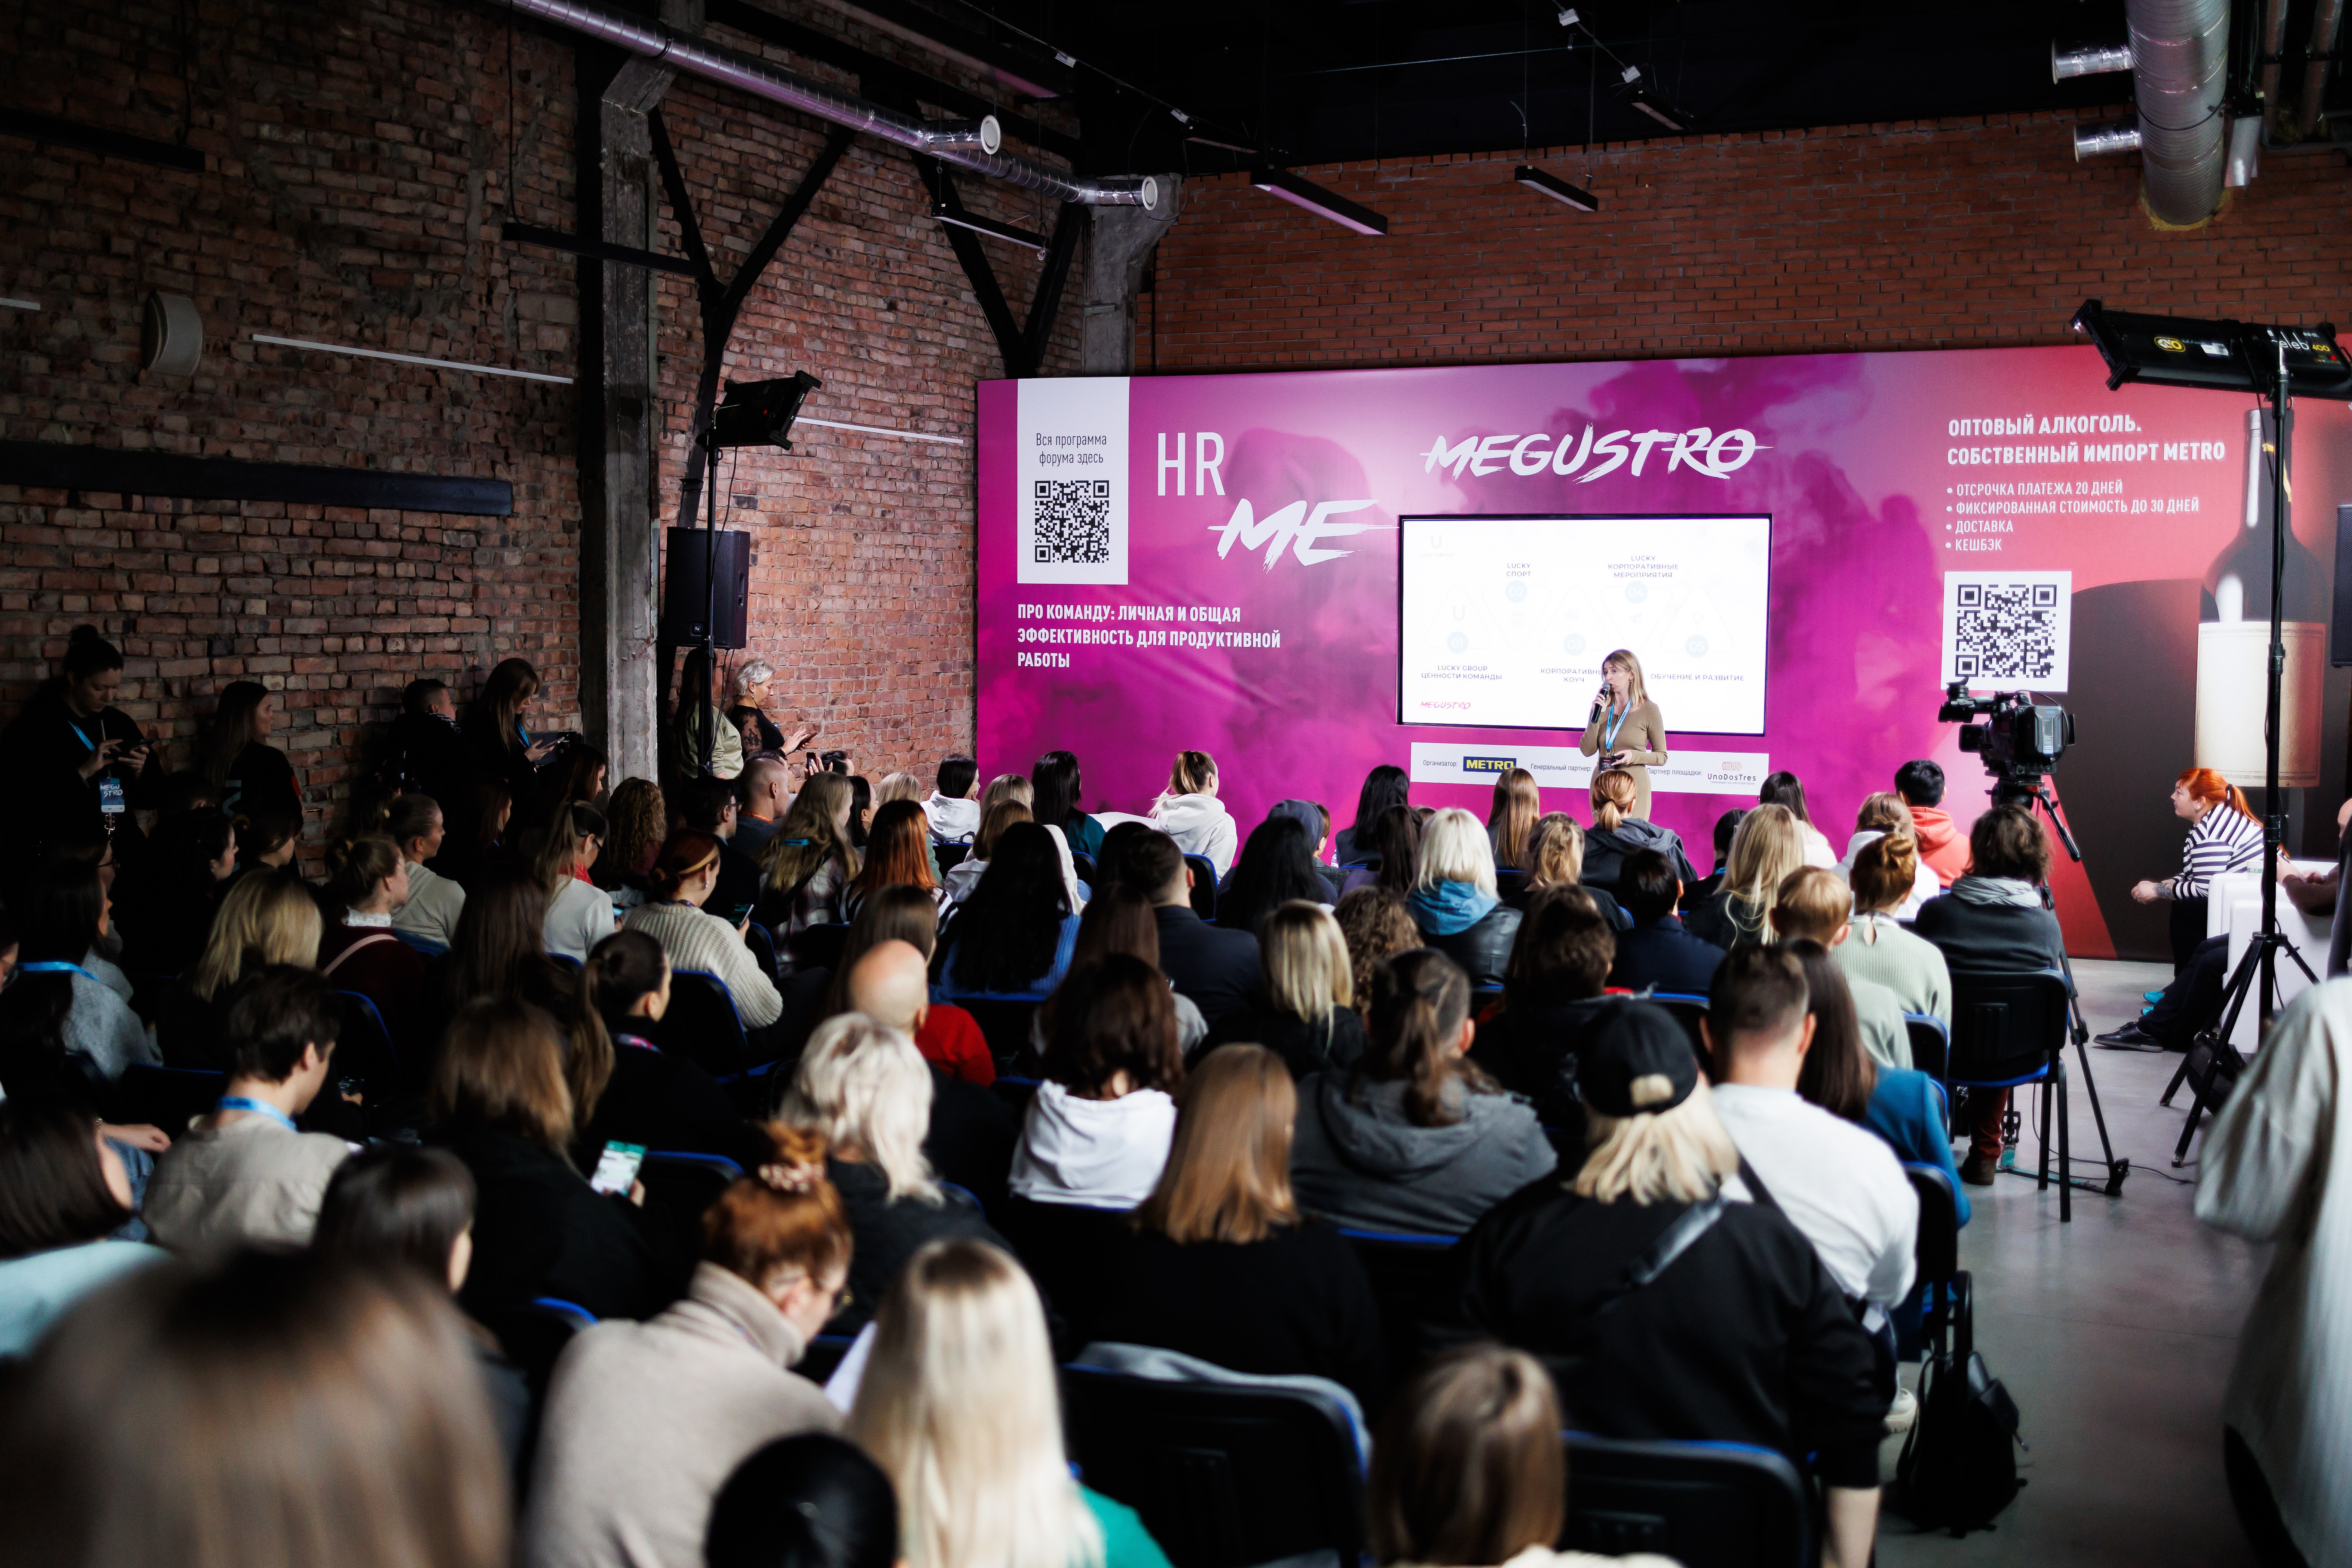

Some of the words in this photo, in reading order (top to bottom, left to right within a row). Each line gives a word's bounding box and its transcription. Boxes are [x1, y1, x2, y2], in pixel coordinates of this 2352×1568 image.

[1948, 414, 2033, 436] ОПТОВЫЙ
[2039, 414, 2141, 435] АЛКОГОЛЬ.
[1036, 433, 1053, 445] Вся
[1056, 435, 1107, 449] программа
[1039, 451, 1074, 467] форума
[1077, 454, 1103, 465] здесь
[1420, 421, 1774, 484] MEGUSTRO
[1948, 442, 2078, 465] СОБСТВЕННЫЙ
[2084, 444, 2159, 462] ИМПОРТ
[2163, 442, 2225, 460] METRO
[1157, 432, 1225, 496] HR
[1956, 483, 2014, 496] ОТСРОЧКА
[2018, 482, 2072, 495] ПЛАТЕЖА
[2076, 482, 2088, 494] 20
[2091, 479, 2122, 496] ДНЕЙ
[1956, 501, 2056, 514] ФИКСИРОВАННАЯ
[2059, 500, 2127, 513] СТОИМОСТЬ
[2131, 500, 2147, 514] ДО
[2150, 499, 2163, 512] 30
[2166, 496, 2199, 513] ДНЕЙ
[1955, 521, 2013, 534] ДОСТАВКА
[1207, 498, 1400, 574] ME
[1955, 539, 2002, 551] КЕШБЭК
[1509, 587, 1524, 597] 02
[1628, 588, 1644, 597] 04
[1018, 604, 1043, 619] ПРО
[1046, 604, 1115, 622] КОМАНДУ:
[1118, 606, 1174, 622] ЛИЧНАЯ
[1177, 606, 1186, 622] И
[1190, 606, 1240, 625] ОБЩАЯ
[1017, 628, 1133, 645] ЭФФЕКТИВНОСТЬ
[1136, 630, 1166, 648] ДЛЯ
[1169, 630, 1280, 649] ПРОДУКТИВНОЙ
[1452, 638, 1464, 648] 01
[1568, 640, 1582, 649] 03
[1689, 642, 1704, 651] 05
[1018, 652, 1070, 668] РАБОТЫ
[1420, 701, 1471, 710] MEGUSTRO
[1467, 760, 1514, 770] METRO
